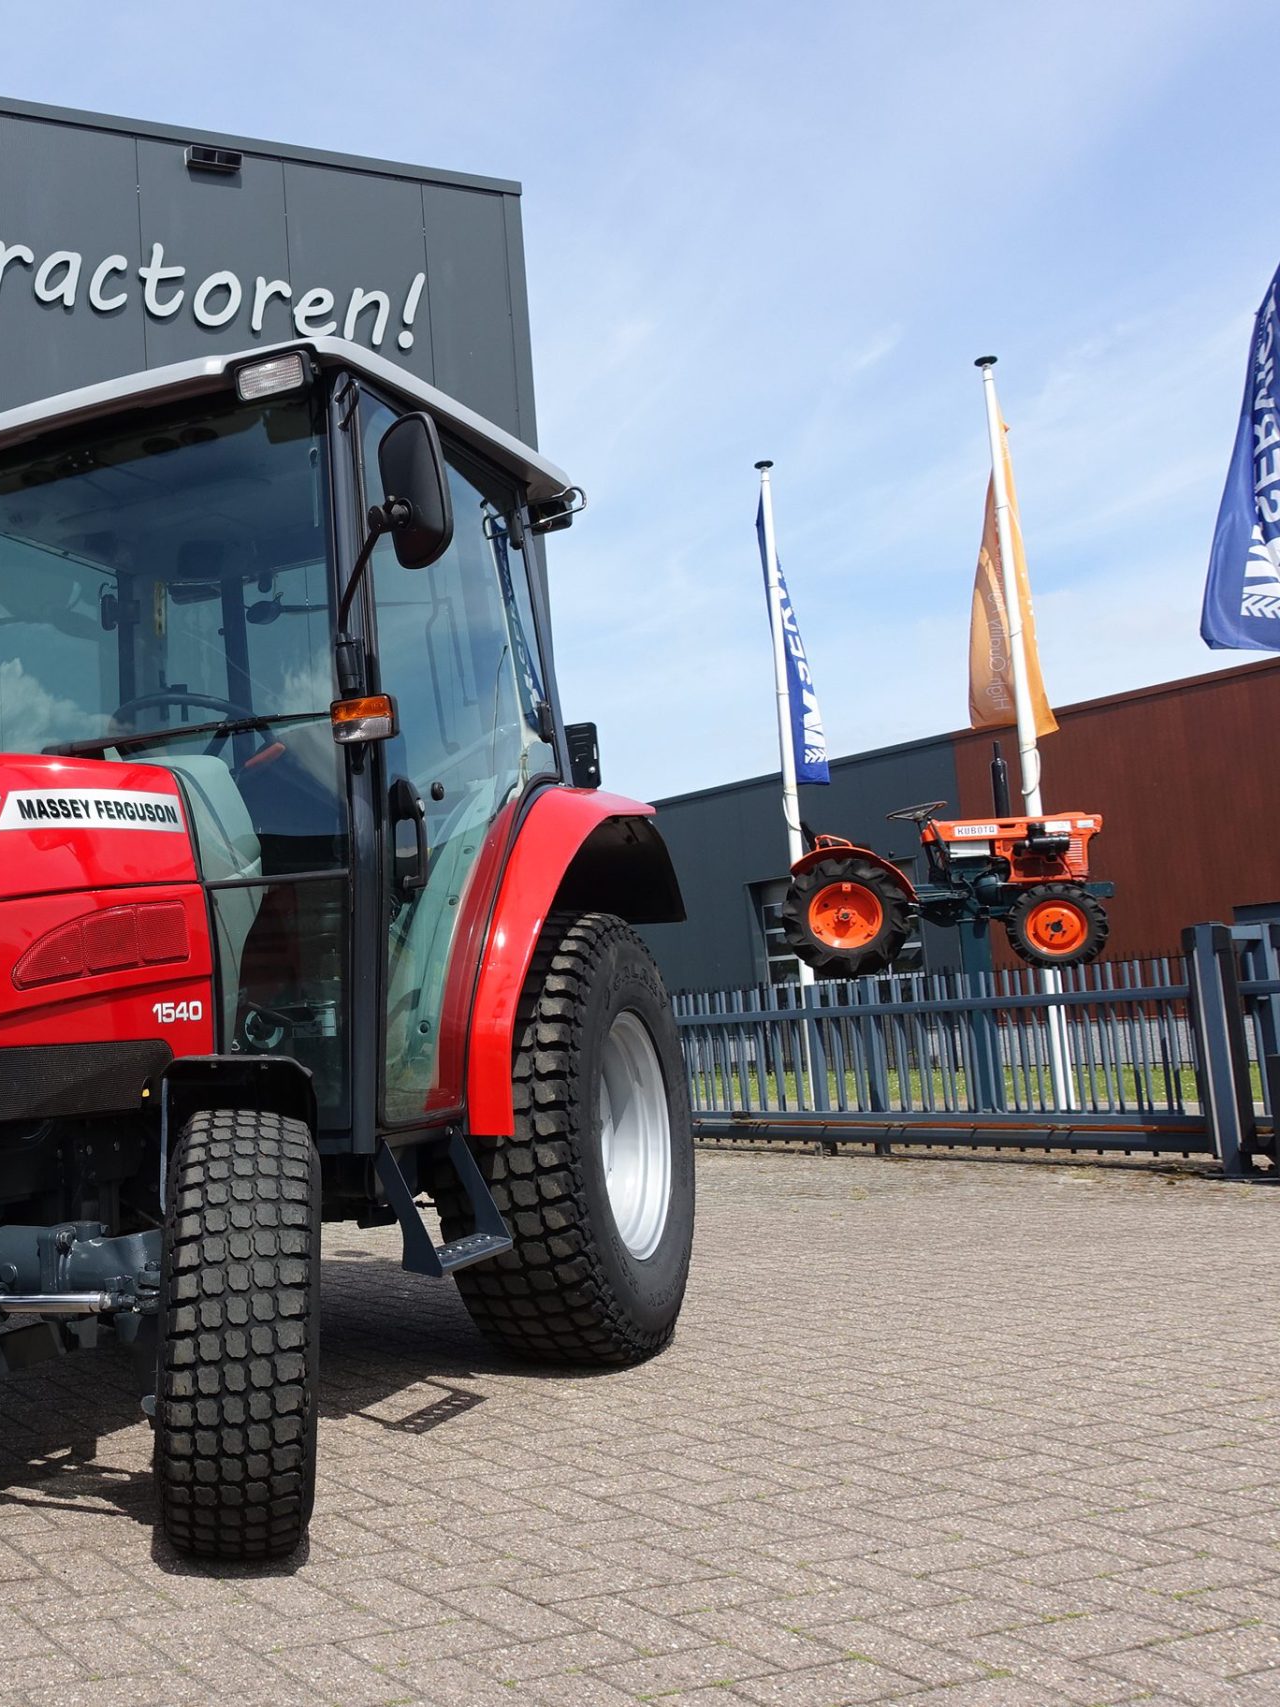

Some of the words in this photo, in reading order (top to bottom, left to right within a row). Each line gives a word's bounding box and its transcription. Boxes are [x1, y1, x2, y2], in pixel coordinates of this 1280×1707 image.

[16, 799, 91, 819] MASSEY
[94, 800, 178, 823] FERGUSON
[957, 826, 995, 835] KUBOTA
[152, 1001, 202, 1023] 1540
